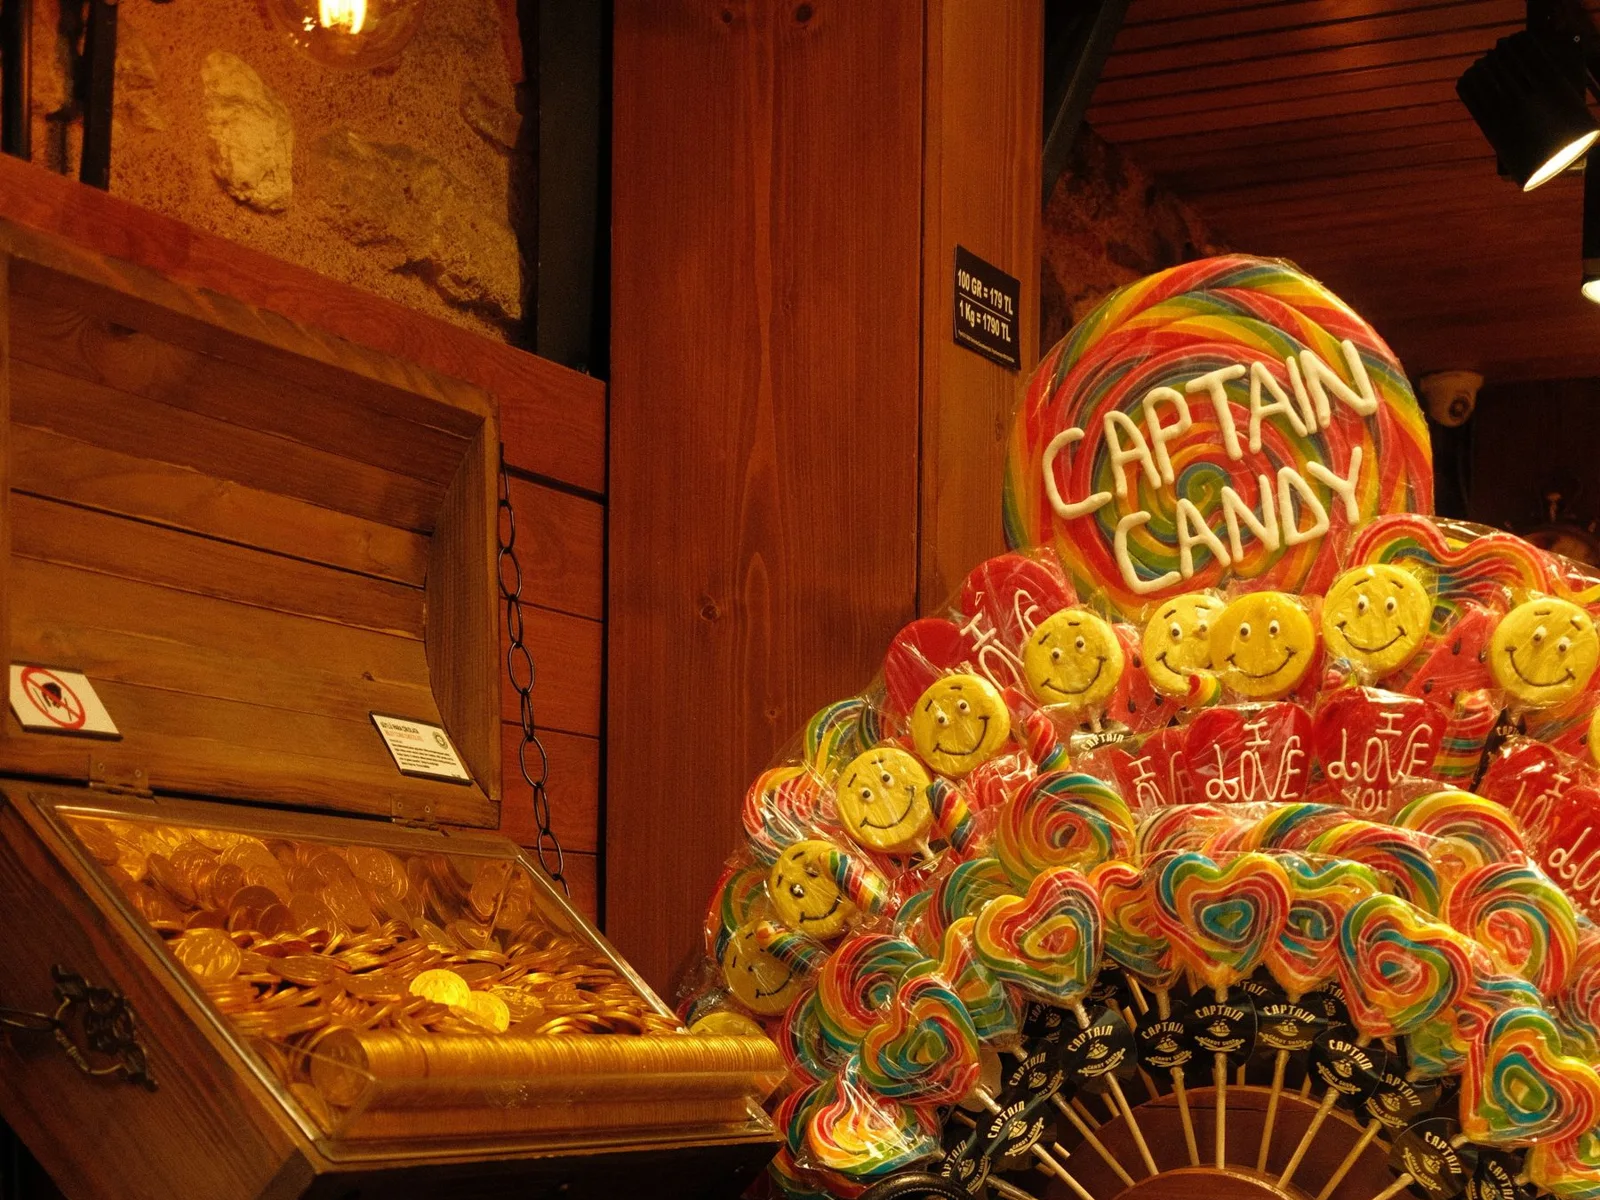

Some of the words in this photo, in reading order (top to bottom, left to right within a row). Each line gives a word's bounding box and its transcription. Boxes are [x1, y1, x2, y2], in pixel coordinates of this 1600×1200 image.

[957, 268, 970, 292] 100
[971, 277, 982, 299] GR
[983, 286, 989, 298] =
[990, 287, 1003, 309] 179
[1003, 295, 1014, 315] TL
[959, 299, 964, 317] 1
[965, 303, 975, 328] Kg
[976, 312, 981, 323] =
[983, 312, 1000, 337] 1790
[1001, 322, 1011, 343] TL
[1042, 339, 1377, 520] CAPTAIN
[1113, 446, 1363, 595] CANDY
[1080, 732, 1125, 751] CAPTAIN
[1242, 720, 1271, 747] I
[1375, 711, 1405, 736] I
[1128, 755, 1157, 784] I
[1205, 735, 1305, 801] LOVE
[1327, 723, 1433, 784] LOVE
[1340, 786, 1393, 813] YOU
[1194, 1004, 1245, 1021] CAPTAIN
[1262, 1004, 1316, 1024] CAPTAIN
[1066, 1024, 1114, 1053] CAPTAIN
[1328, 1039, 1374, 1071] CAPTAIN
[1008, 1051, 1047, 1087] CAPTAIN
[987, 1100, 1025, 1139] CAPTAIN
[941, 1139, 968, 1178] APTAIN
[1424, 1131, 1462, 1174] CAPTAIN
